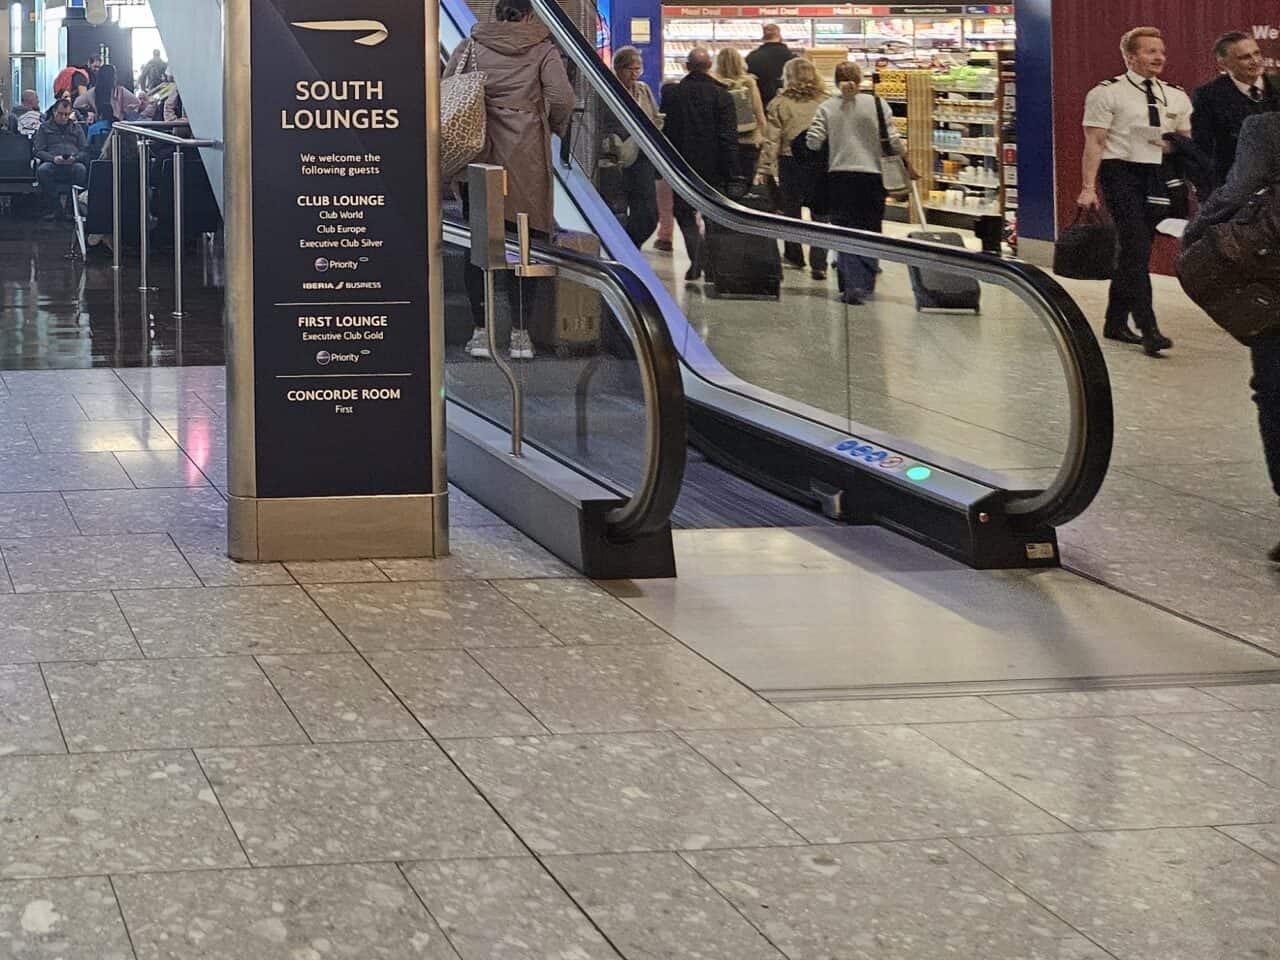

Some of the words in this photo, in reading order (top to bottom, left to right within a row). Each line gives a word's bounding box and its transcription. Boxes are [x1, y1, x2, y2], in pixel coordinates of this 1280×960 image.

[296, 81, 382, 100] SOUTH
[282, 109, 399, 129] LOUNGES
[300, 153, 316, 163] We
[318, 153, 362, 163] welcome
[364, 152, 381, 163] the
[301, 165, 346, 177] following
[348, 166, 380, 177] guests
[296, 195, 330, 207] CLUB
[333, 194, 385, 206] LOUNGE
[319, 210, 339, 220] Club
[339, 210, 364, 220] World
[316, 224, 336, 234] Club
[336, 224, 367, 235] Europe
[299, 239, 340, 248] Executive
[340, 238, 360, 248] Club
[360, 238, 384, 248] Silver
[329, 259, 359, 270] Priority
[302, 282, 335, 290] IBERIA
[298, 316, 333, 328] FIRST
[335, 315, 388, 328] LOUNGE
[302, 331, 342, 341] Executive
[343, 330, 363, 341] Club
[363, 330, 384, 340] Gold
[330, 352, 360, 363] Priority
[287, 389, 359, 402] CONCORDE
[361, 388, 401, 400] ROOM
[335, 404, 353, 414] First
